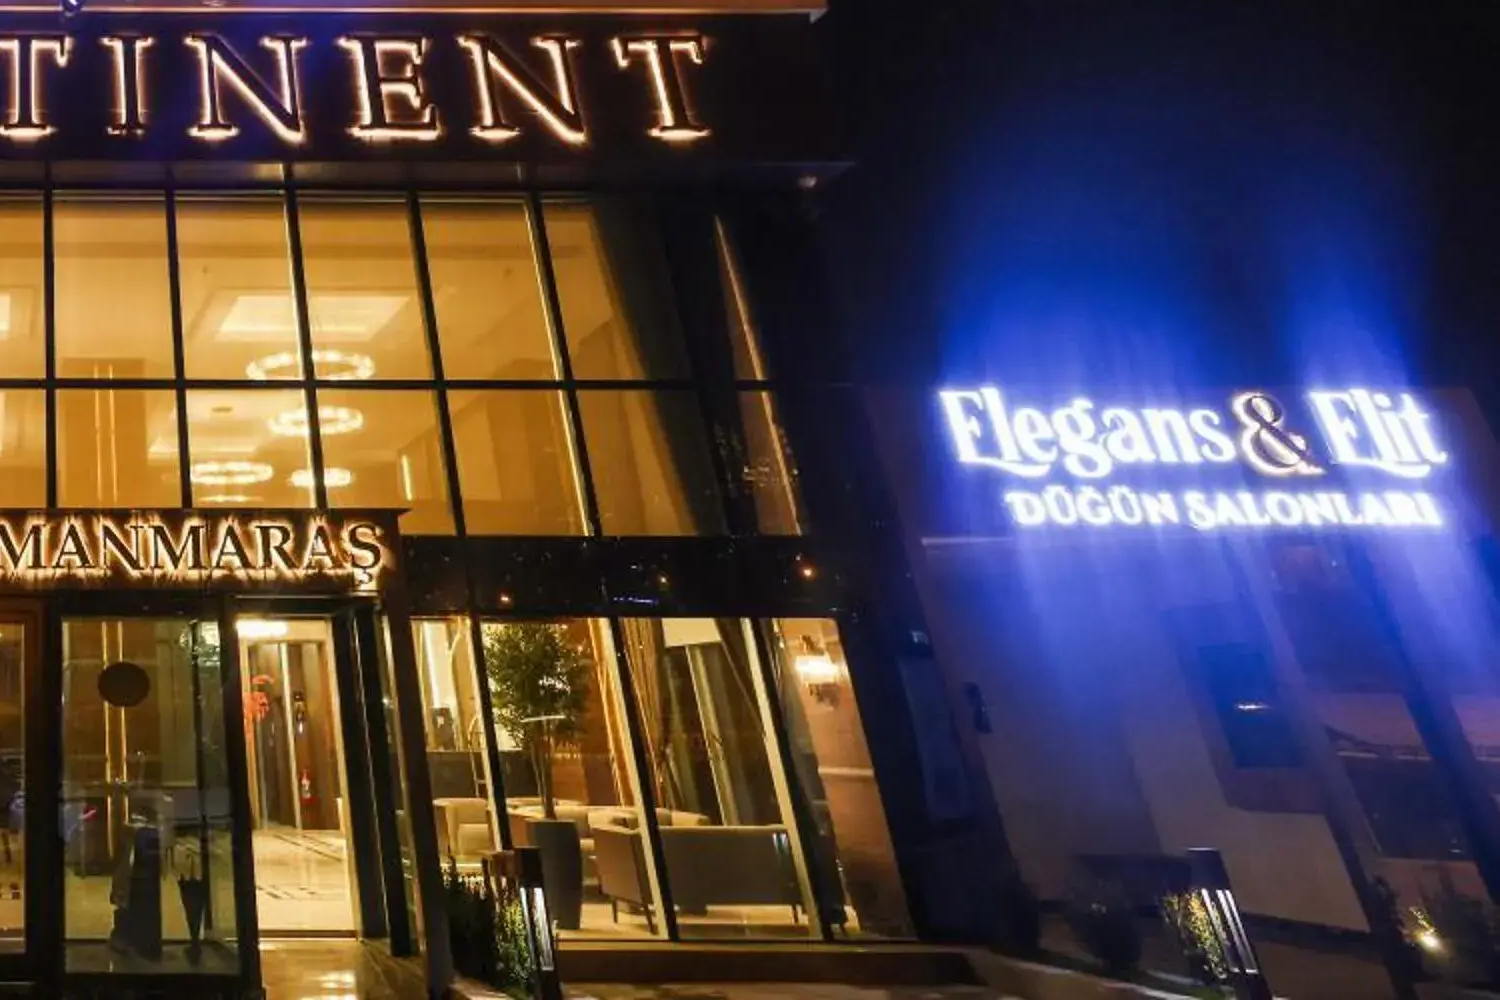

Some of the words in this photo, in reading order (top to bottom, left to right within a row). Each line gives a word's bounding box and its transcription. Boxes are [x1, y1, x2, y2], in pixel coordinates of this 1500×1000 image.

[939, 385, 1237, 478] Elegans
[1232, 390, 1328, 476] &
[1310, 388, 1449, 479] Elit
[1183, 489, 1445, 531] SALONLARI
